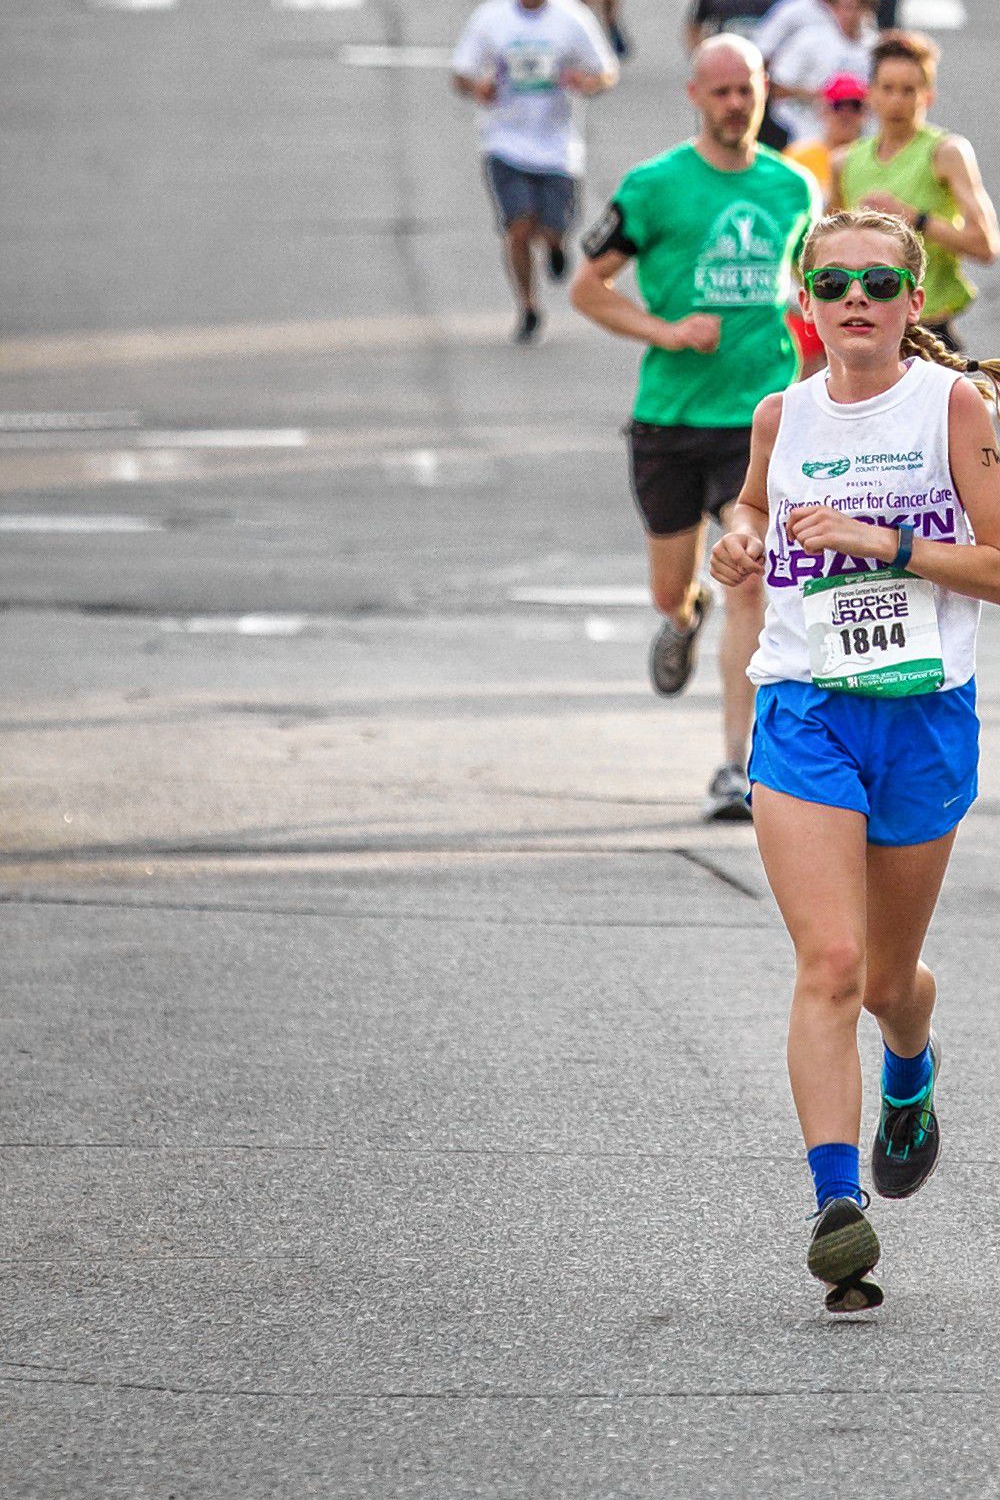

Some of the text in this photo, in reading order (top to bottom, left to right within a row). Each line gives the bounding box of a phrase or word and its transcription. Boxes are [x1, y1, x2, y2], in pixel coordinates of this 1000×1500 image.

[855, 450, 924, 465] MERRIMACK
[855, 462, 924, 473] COUNTY SAVINGS BANK
[846, 480, 883, 488] PRESENTS
[823, 494, 865, 513] Center
[866, 492, 883, 509] for
[886, 490, 928, 509] Cancer
[929, 486, 953, 505] Care
[838, 591, 908, 611] ROCK'N
[836, 602, 910, 624] RACE
[839, 622, 907, 656] 1844
